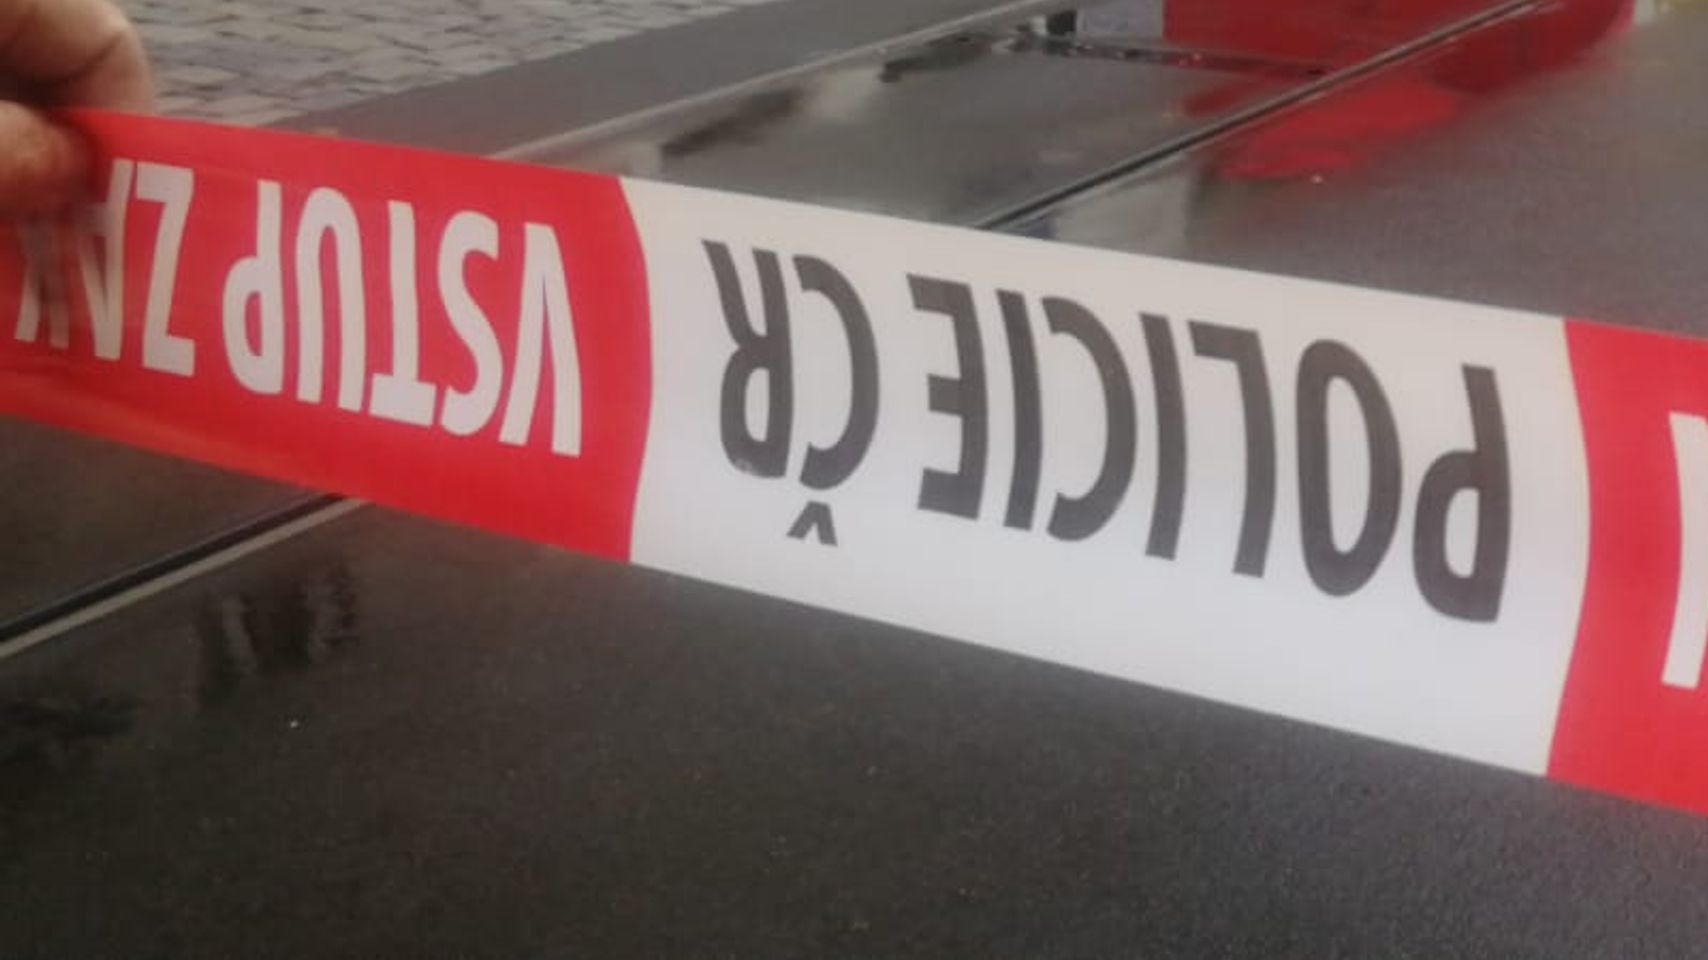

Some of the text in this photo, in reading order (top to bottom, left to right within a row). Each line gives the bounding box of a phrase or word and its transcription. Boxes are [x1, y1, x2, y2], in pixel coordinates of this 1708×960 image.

[221, 178, 583, 458] VSTUP
[701, 239, 880, 547] ČR
[907, 273, 1511, 624] POLICIE
